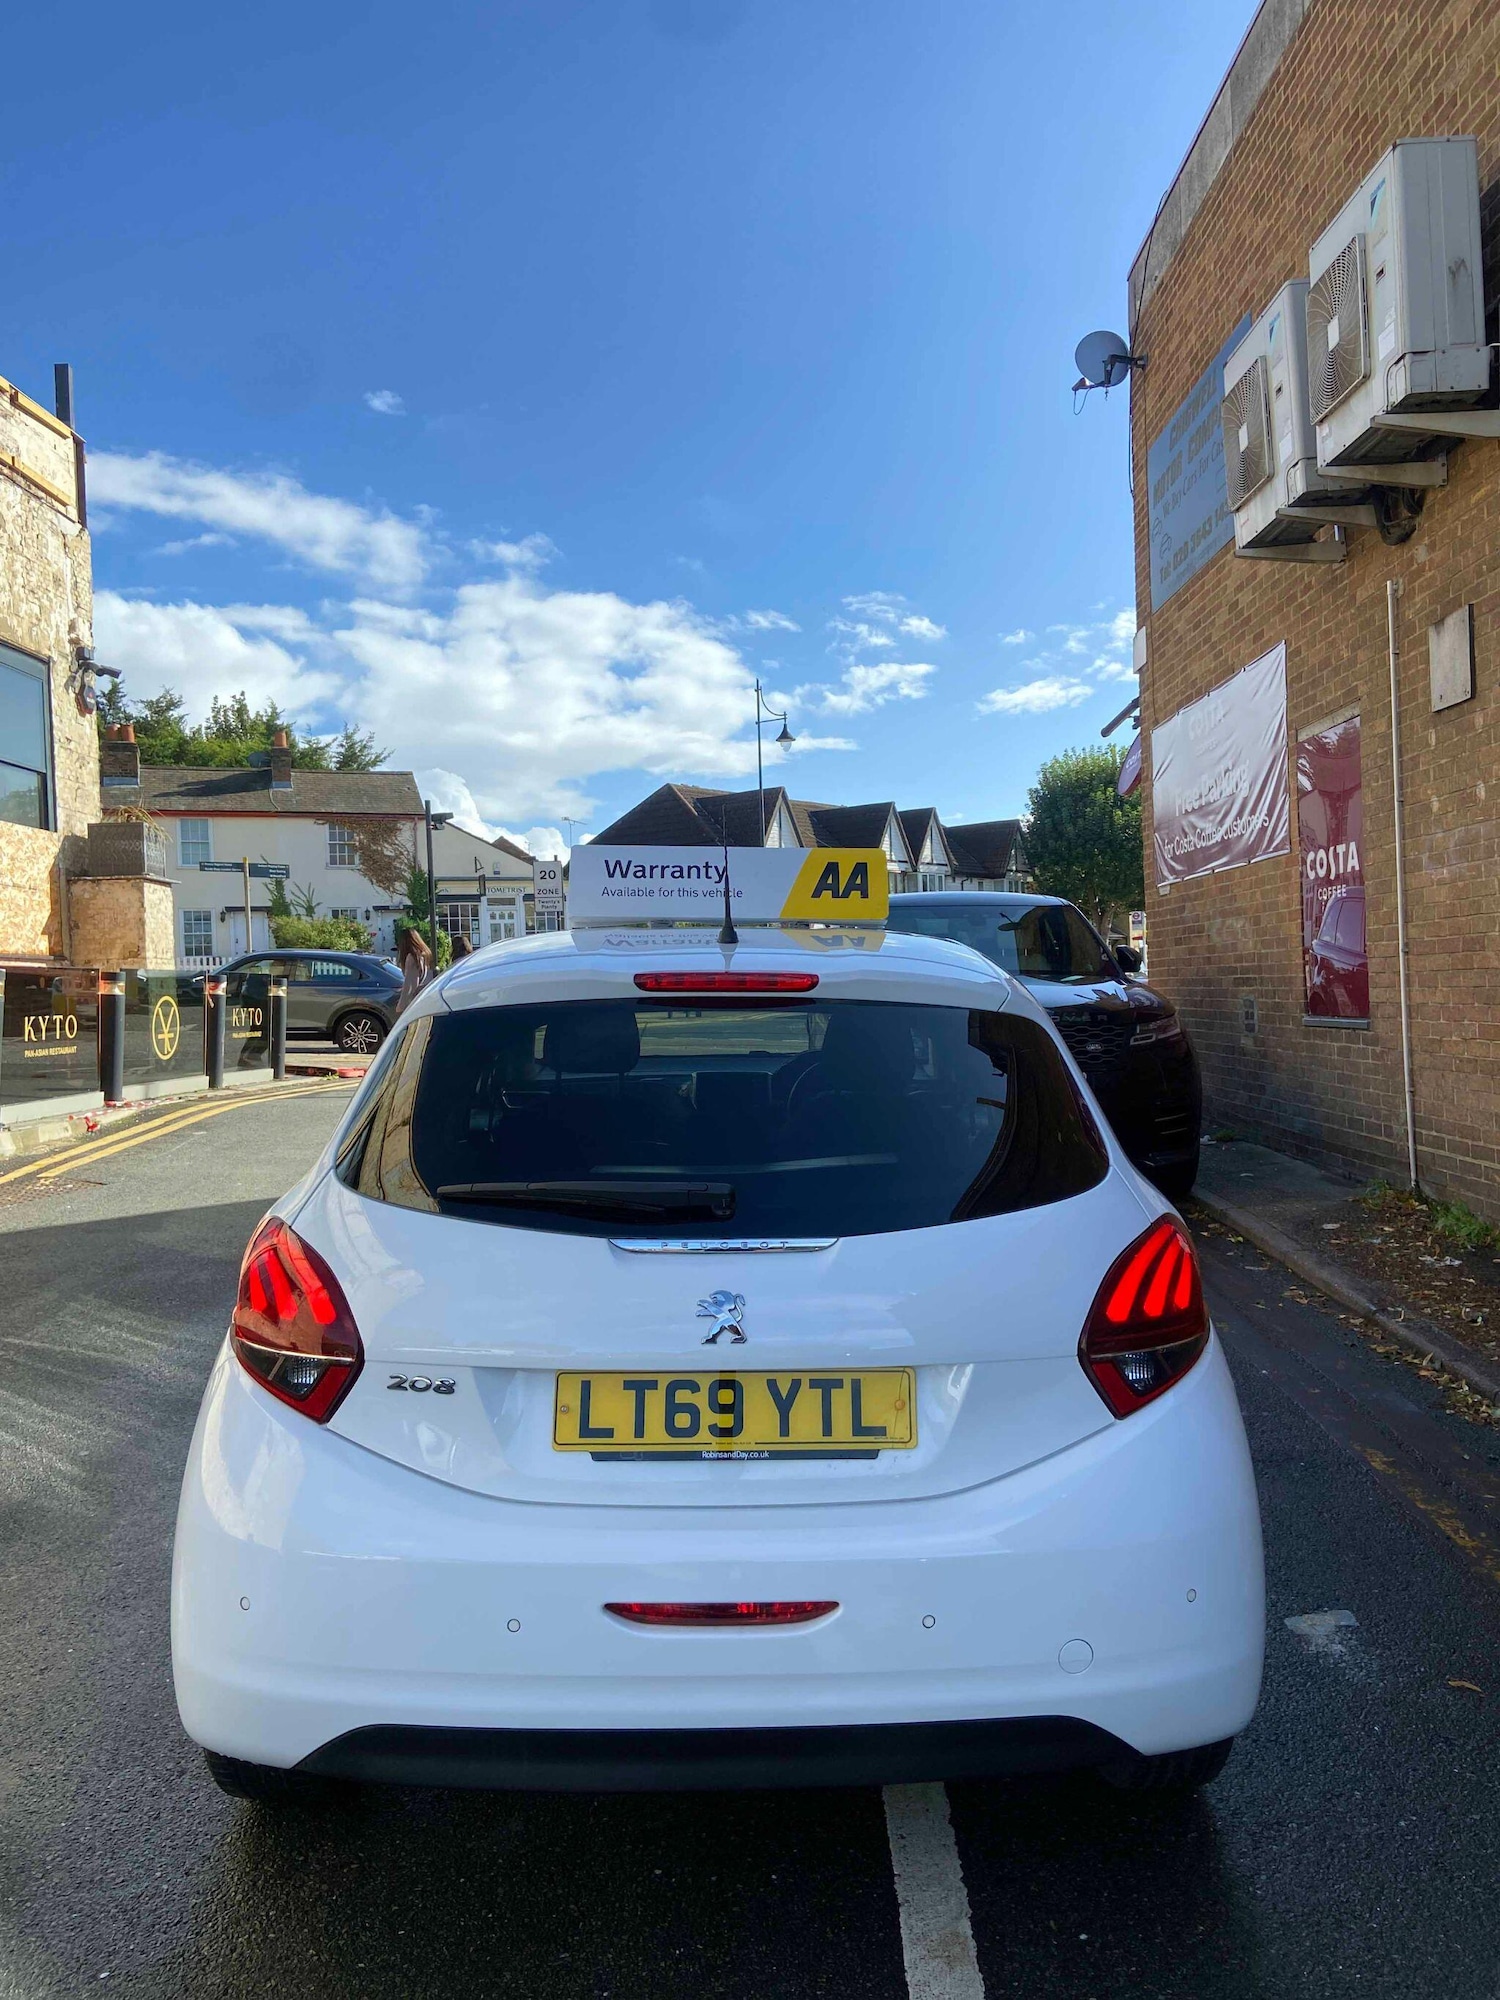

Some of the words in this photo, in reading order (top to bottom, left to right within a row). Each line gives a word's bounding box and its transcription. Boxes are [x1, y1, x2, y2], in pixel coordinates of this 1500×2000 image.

[1176, 786, 1199, 816] Free
[1201, 762, 1249, 806] Parking
[1164, 839, 1174, 859] for
[1174, 835, 1195, 855] Costa
[1195, 823, 1223, 849] Coffee
[1223, 811, 1269, 840] customers
[1307, 841, 1360, 880] COSTA
[540, 870, 556, 880] 20
[604, 860, 726, 884] Warranty
[811, 862, 869, 898] AA
[601, 886, 655, 897] Available
[658, 887, 675, 898] for
[678, 887, 699, 898] this
[1318, 884, 1347, 900] COFFEE
[24, 1014, 78, 1042] KYTO
[232, 1007, 263, 1027] KYTO
[661, 1241, 789, 1249] PEUGEOT
[387, 1373, 456, 1394] 208
[579, 1379, 744, 1438] LT69
[766, 1378, 887, 1437] YTL
[702, 1450, 770, 1460] RobinsandDay.co.uk
